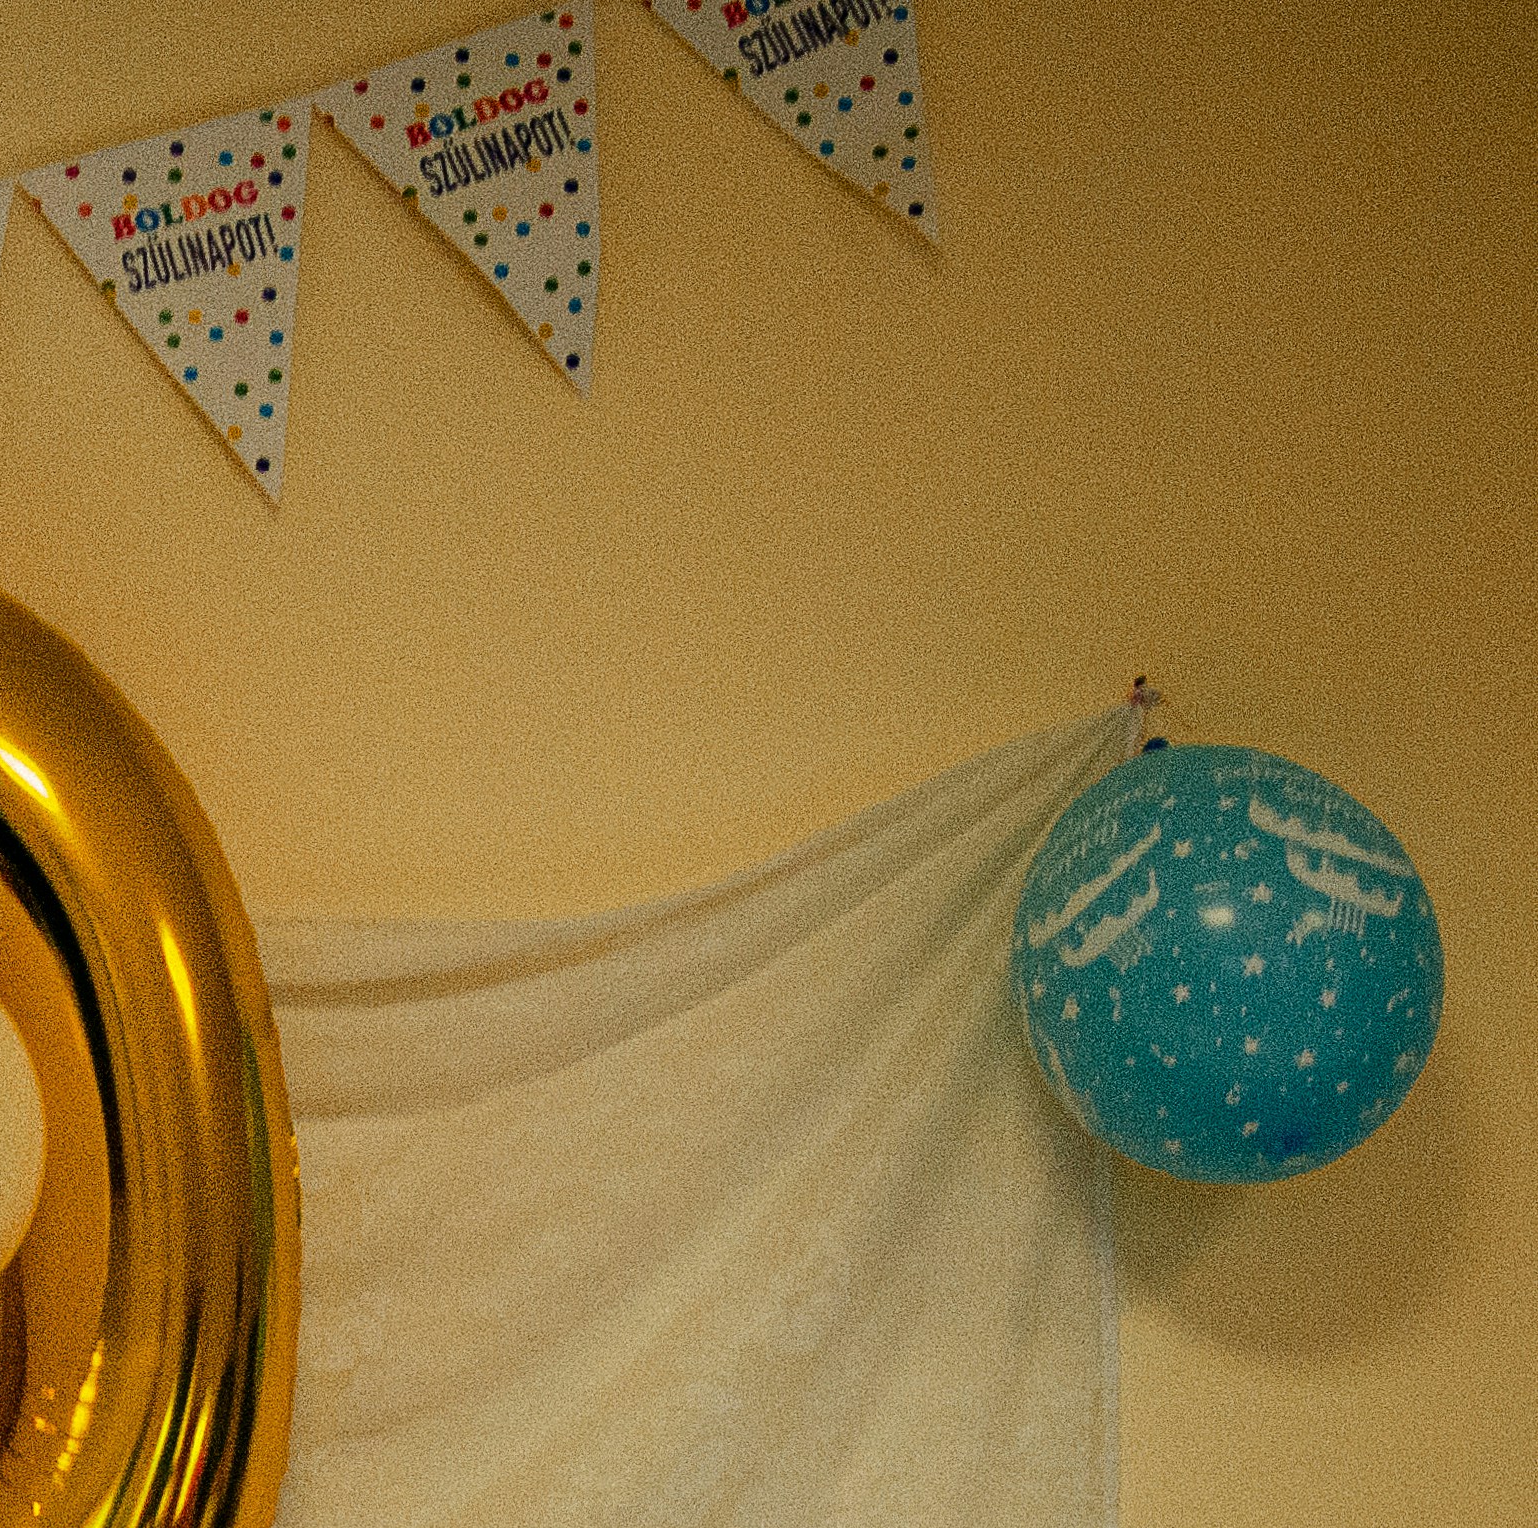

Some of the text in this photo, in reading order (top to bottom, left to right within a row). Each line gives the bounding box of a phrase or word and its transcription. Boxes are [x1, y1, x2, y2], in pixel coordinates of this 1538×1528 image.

[405, 78, 551, 148] BOLDOG
[420, 109, 575, 197] SZÜLINAPOT!
[111, 180, 259, 241] BOLDOG
[122, 215, 278, 293] SZÜLINAPOT!
